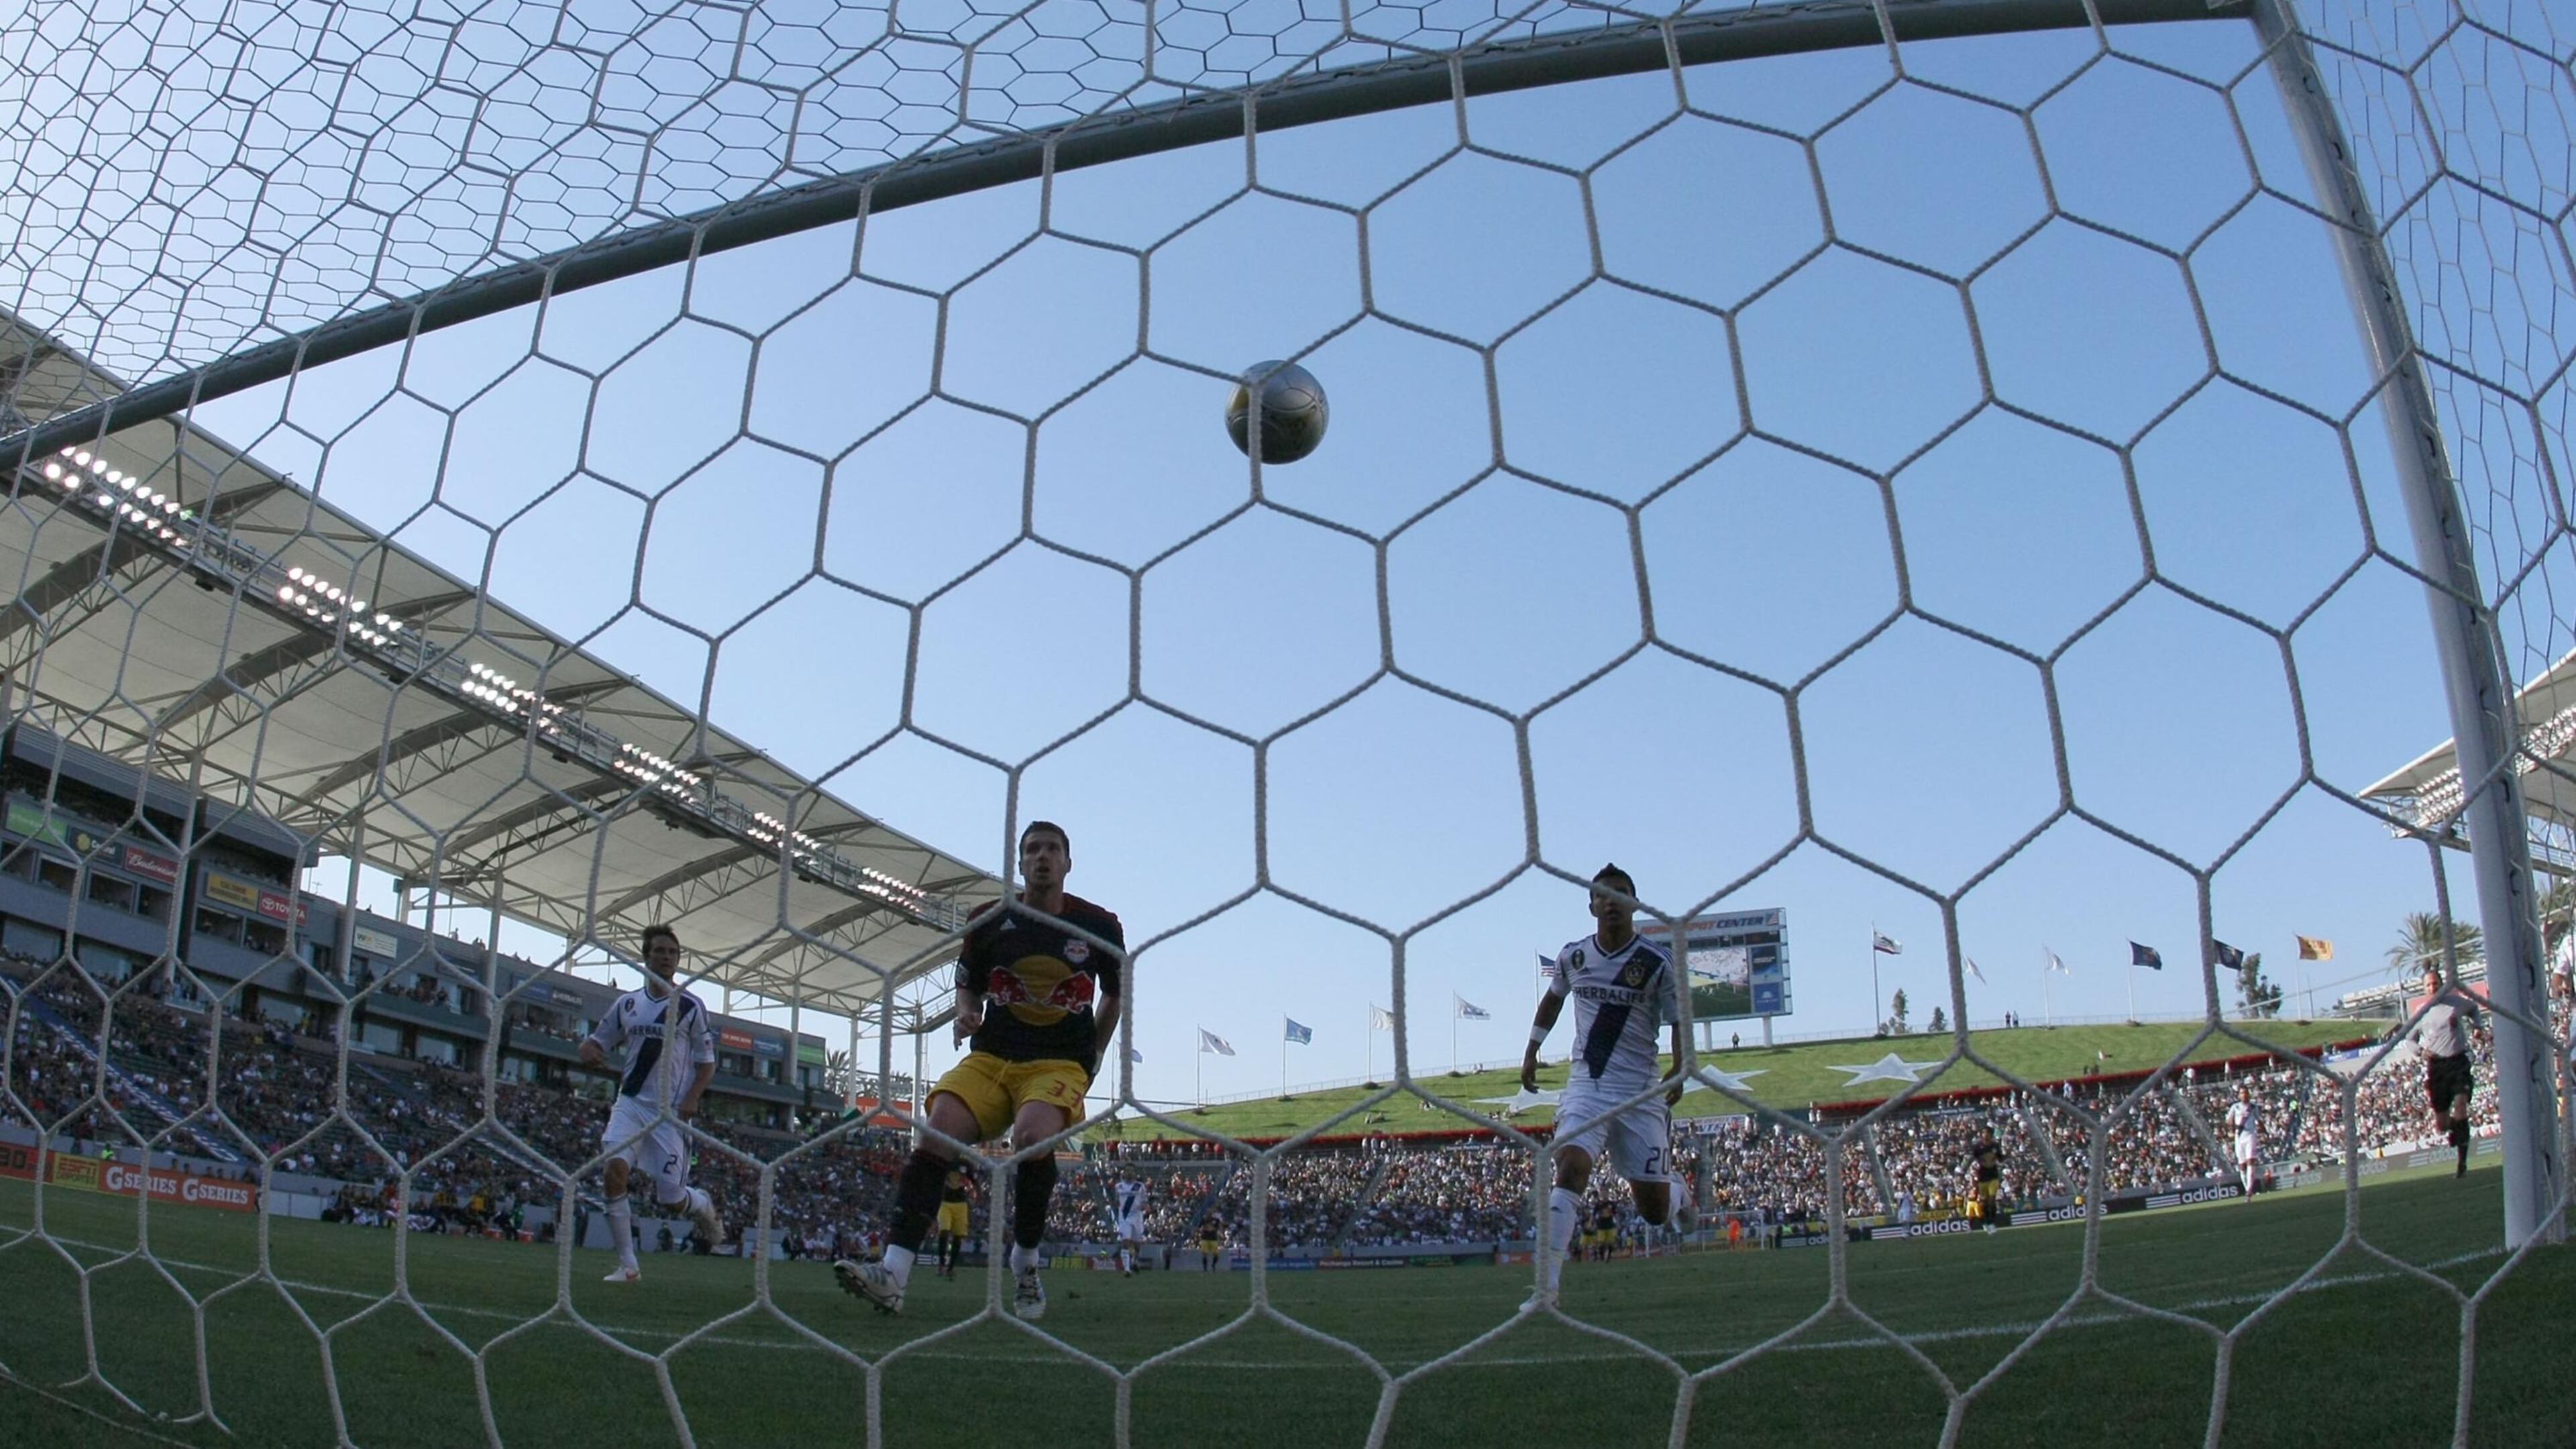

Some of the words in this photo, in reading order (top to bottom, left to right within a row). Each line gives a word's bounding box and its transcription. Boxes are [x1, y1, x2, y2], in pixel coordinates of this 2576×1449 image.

[274, 902, 306, 919] TOYTA
[1717, 916, 1764, 928] CENTER
[1574, 987, 1646, 1003] HERBALIFE
[1646, 1146, 1670, 1175] 20
[2182, 1185, 2239, 1203] adidas
[2049, 1203, 2108, 1221] adids
[1911, 1219, 1971, 1236] adidas
